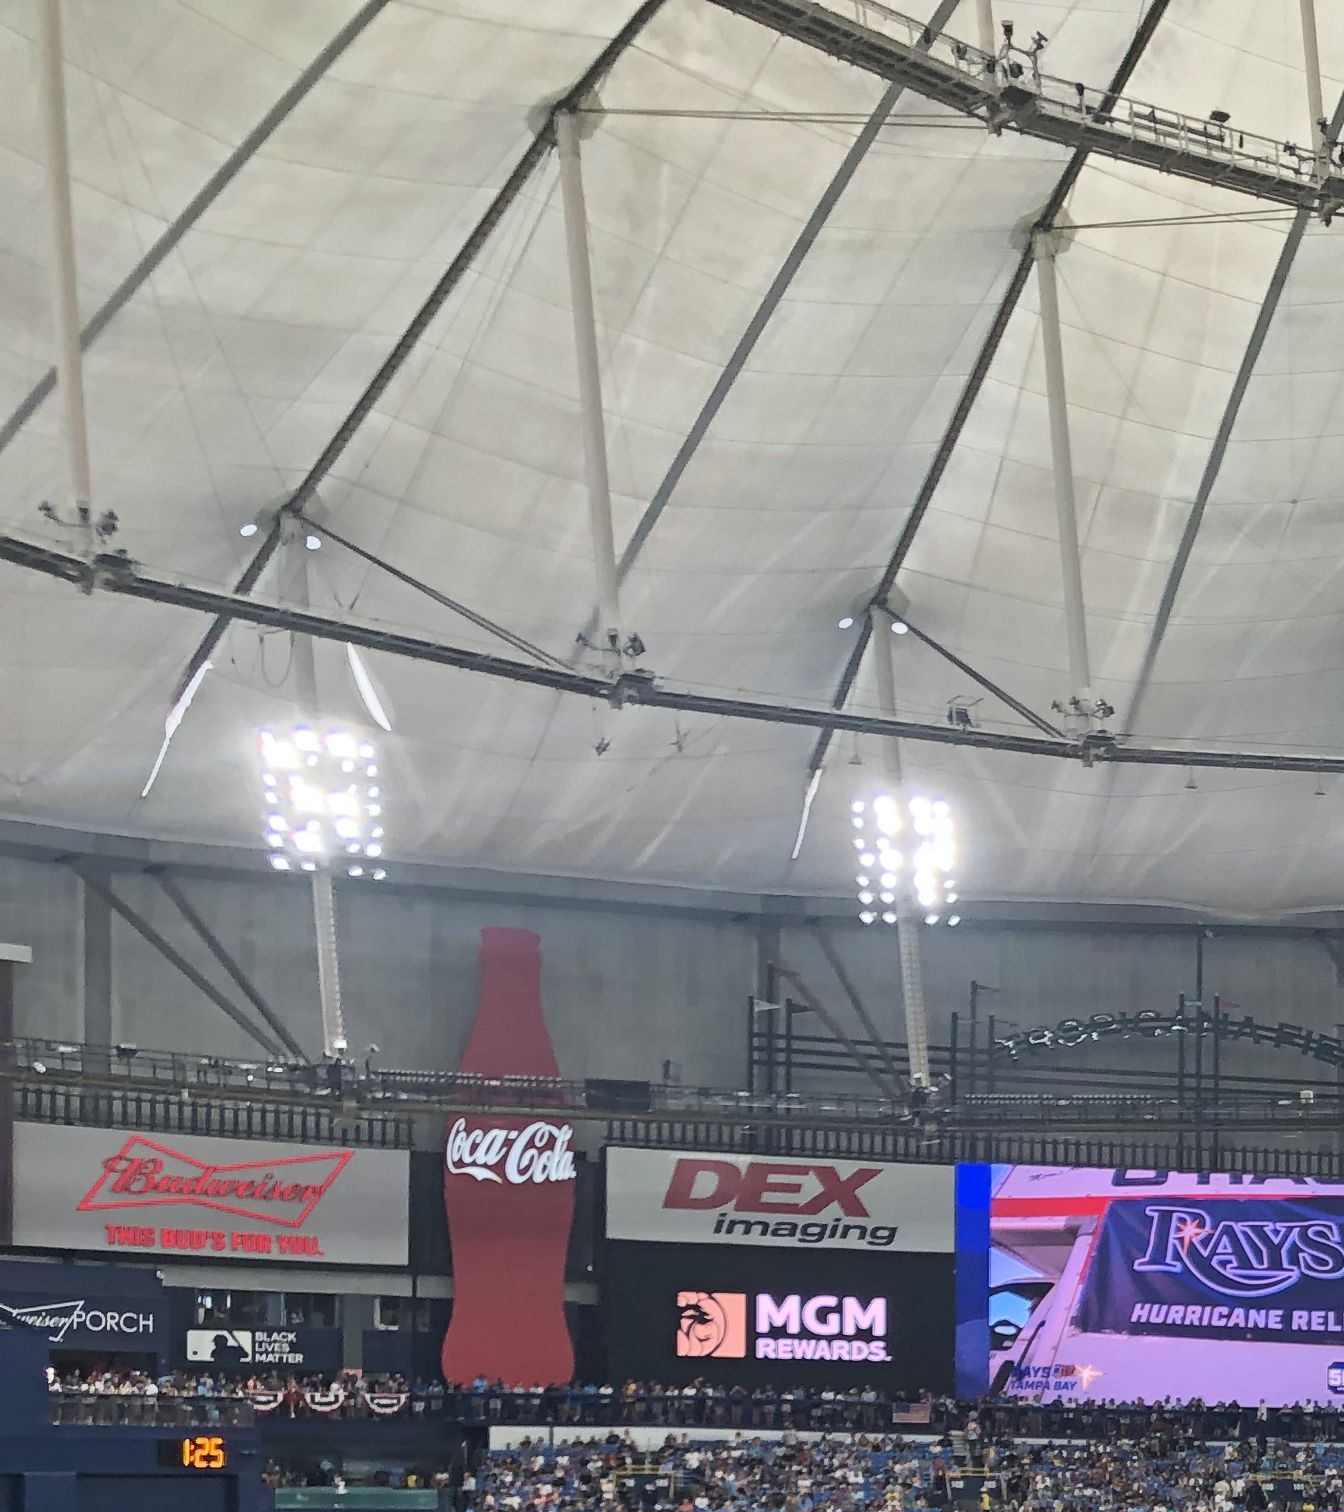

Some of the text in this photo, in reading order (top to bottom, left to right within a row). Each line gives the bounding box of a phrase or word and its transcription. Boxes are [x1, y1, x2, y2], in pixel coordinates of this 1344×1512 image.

[446, 1116, 577, 1185] Coca-Cola
[104, 1153, 324, 1202] Budweiser
[662, 1158, 884, 1218] DEX
[105, 1224, 325, 1256] THIS BUD'S FOR YOU.
[713, 1212, 899, 1246] imaging
[73, 1310, 154, 1333] PORCH
[756, 1293, 886, 1337] MGM
[1130, 1303, 1284, 1329] HURRICANE
[255, 1331, 297, 1343] BLACK
[255, 1342, 291, 1354] LIVES
[255, 1352, 304, 1364] MATTER
[1010, 1381, 1077, 1391] TAMPA BAY
[182, 1437, 225, 1468] 1:25
